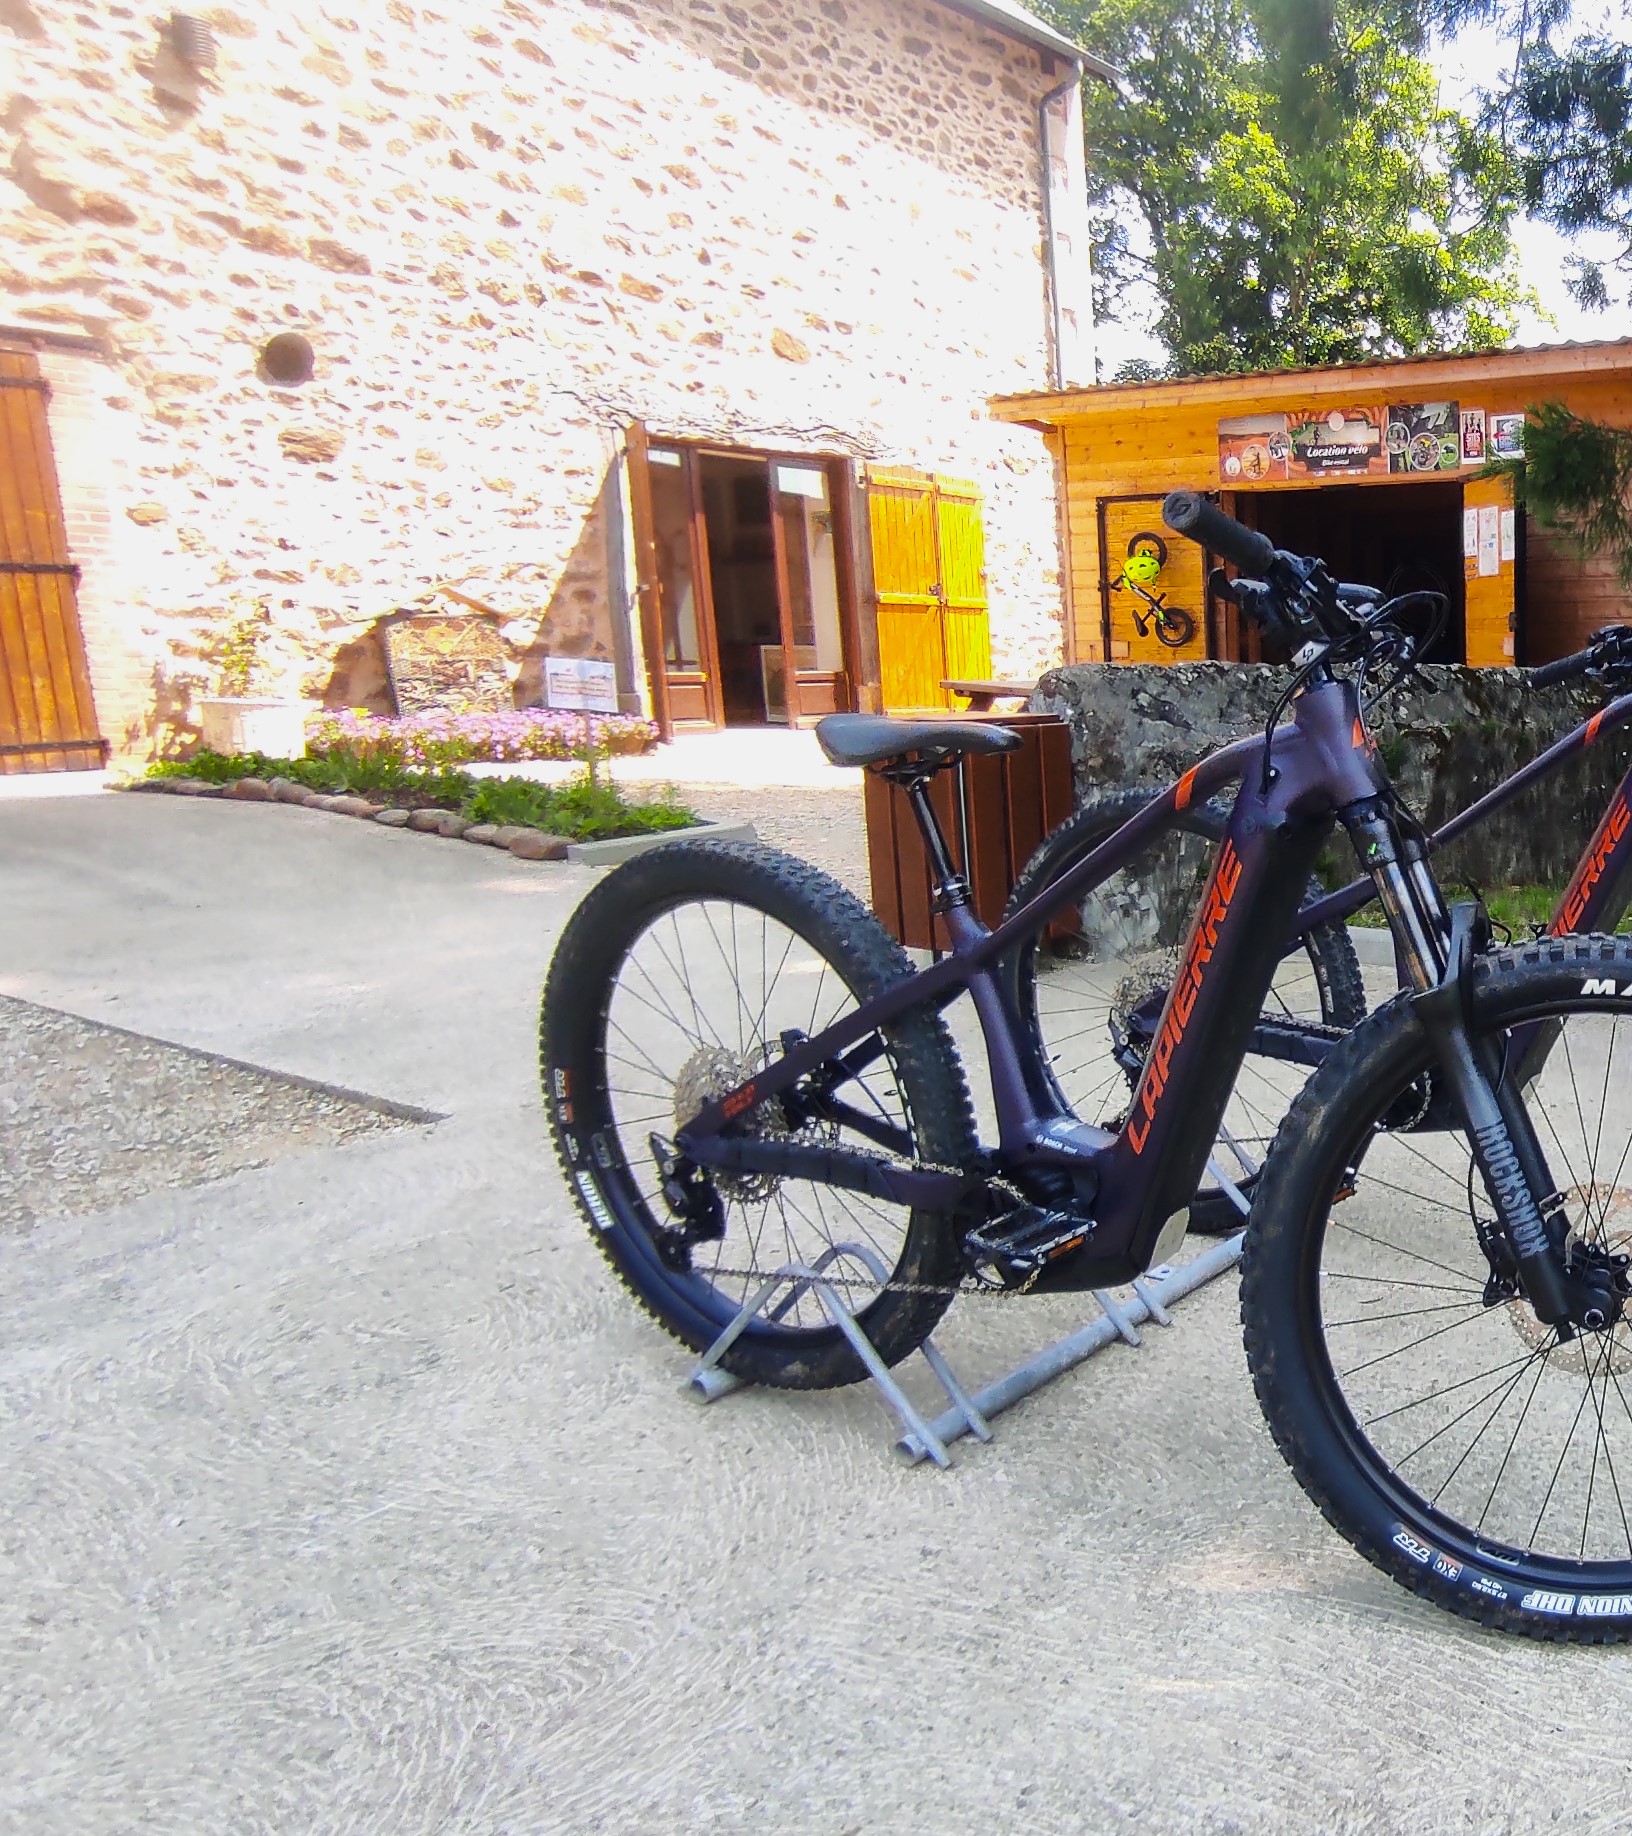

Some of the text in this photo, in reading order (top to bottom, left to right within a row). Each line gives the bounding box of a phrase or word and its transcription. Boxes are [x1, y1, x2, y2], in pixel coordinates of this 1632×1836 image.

[1307, 445, 1346, 457] Location
[1552, 796, 1631, 938] IERRE
[1127, 837, 1243, 1155] LAPIERRE
[1476, 1121, 1550, 1259] ROCKSHOX
[1436, 1559, 1459, 1579] EXO
[1521, 1589, 1576, 1615] DHF
